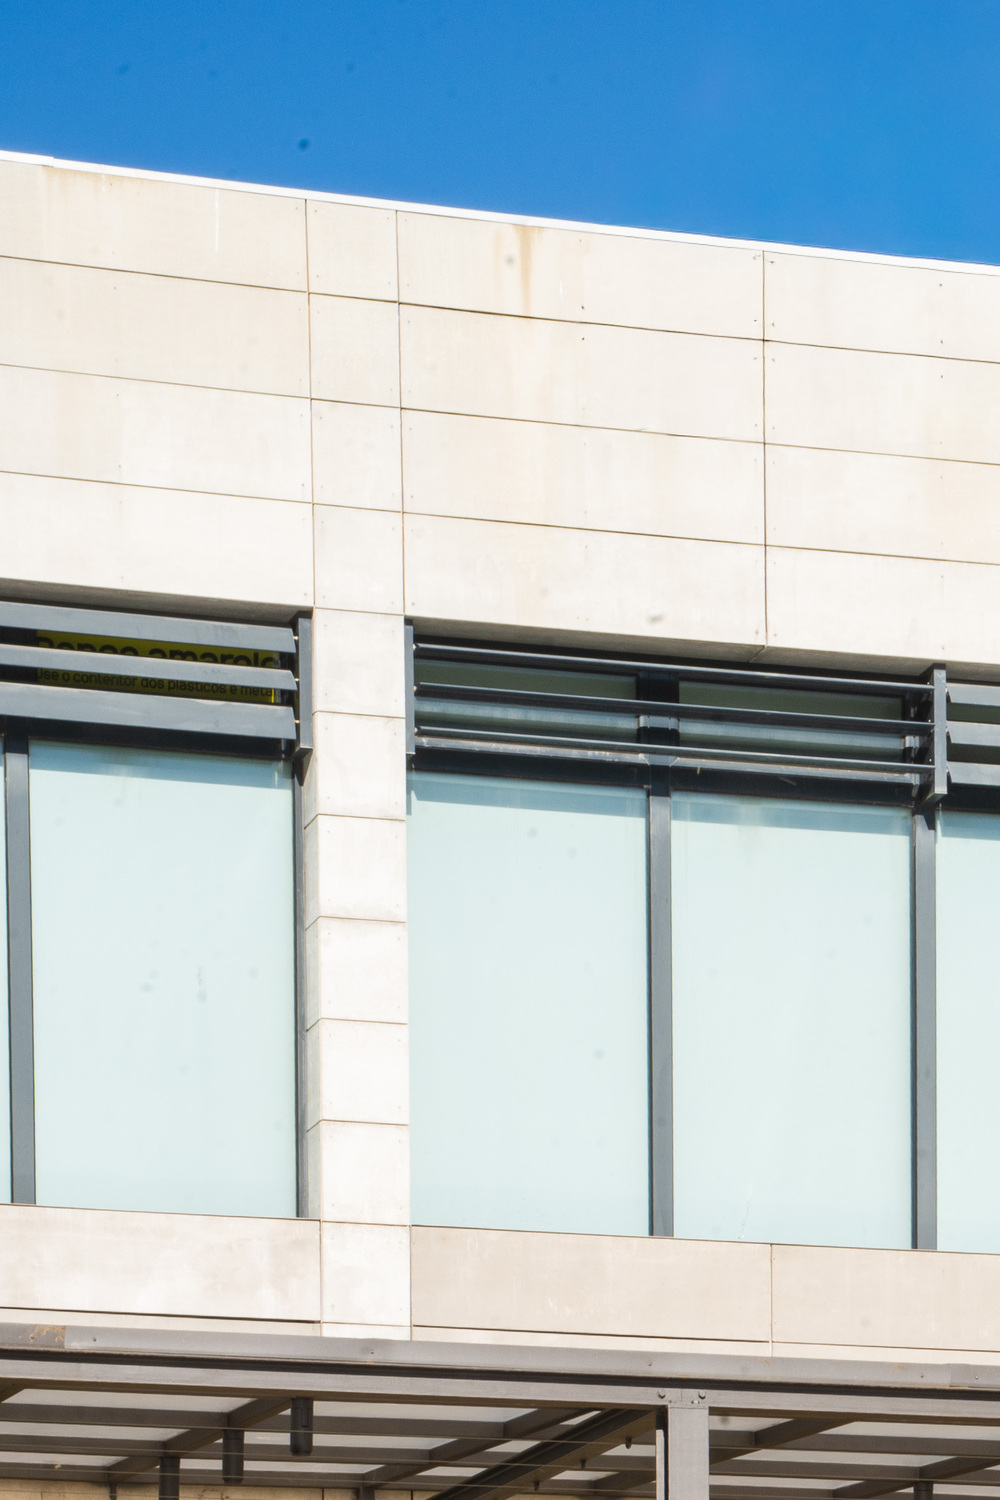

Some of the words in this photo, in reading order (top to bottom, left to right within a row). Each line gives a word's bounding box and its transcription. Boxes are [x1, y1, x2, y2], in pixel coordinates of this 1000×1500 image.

[62, 671, 71, 682] o
[73, 672, 137, 687] contentor
[141, 677, 165, 690] dos
